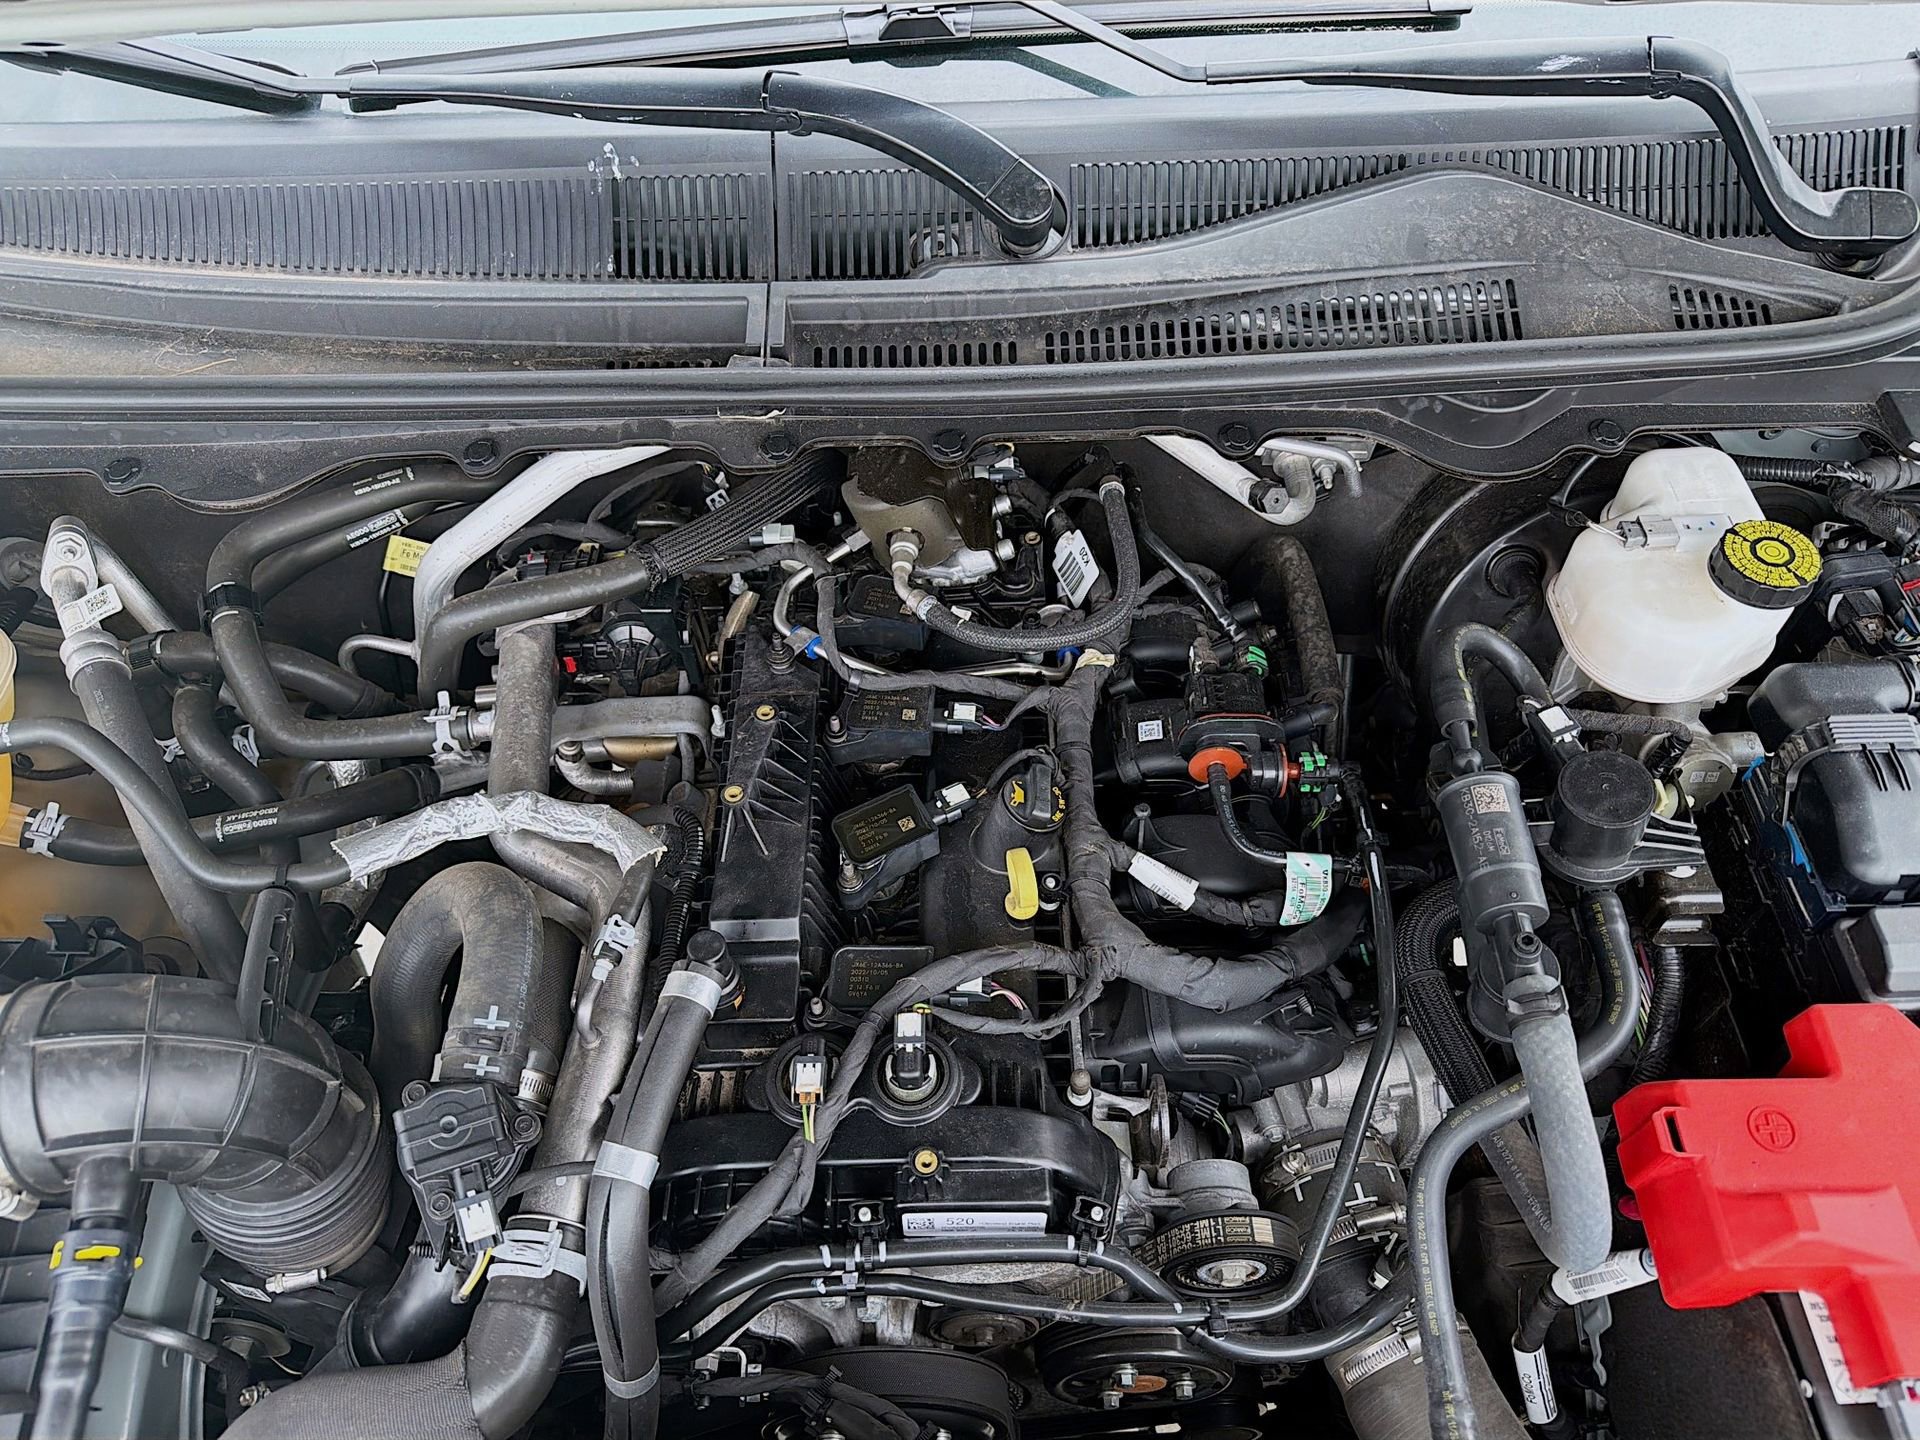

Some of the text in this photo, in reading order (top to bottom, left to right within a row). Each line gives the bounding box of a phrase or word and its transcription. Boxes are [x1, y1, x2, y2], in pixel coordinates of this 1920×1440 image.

[1292, 882, 1306, 920] FoMoCo
[946, 1217, 975, 1226] 520
[1521, 1372, 1538, 1405] FoMoCo
